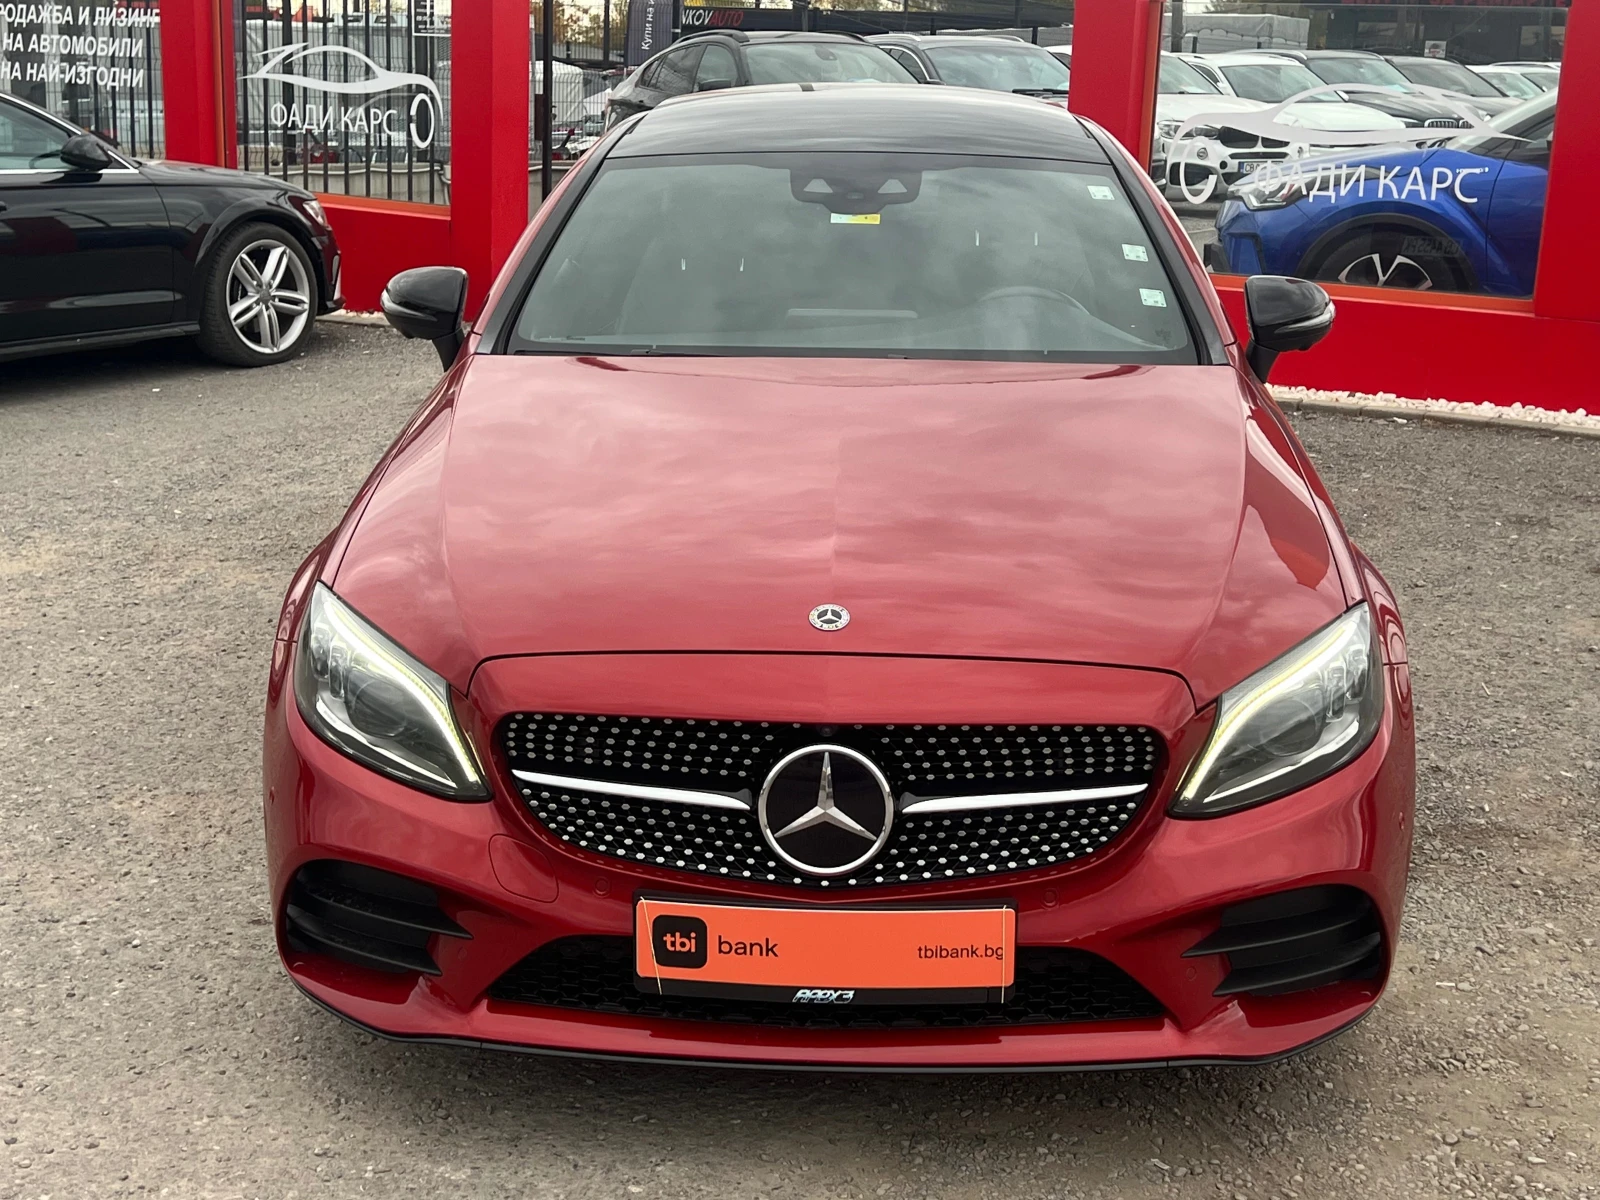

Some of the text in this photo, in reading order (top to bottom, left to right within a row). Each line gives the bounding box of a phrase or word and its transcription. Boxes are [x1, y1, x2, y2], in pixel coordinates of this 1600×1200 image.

[78, 6, 90, 26] И
[93, 6, 161, 28] ЛИЗИНГ
[3, 32, 143, 58] НА АВТОМОБИЛИ
[0, 60, 144, 91] НА НАЙ-ИЗГОДНИ
[270, 101, 398, 136] ФАДИ КАРС
[1254, 160, 1478, 204] ФАДИ КАРС
[663, 932, 779, 958] tbi bank
[917, 944, 1004, 961] tbibank.bg
